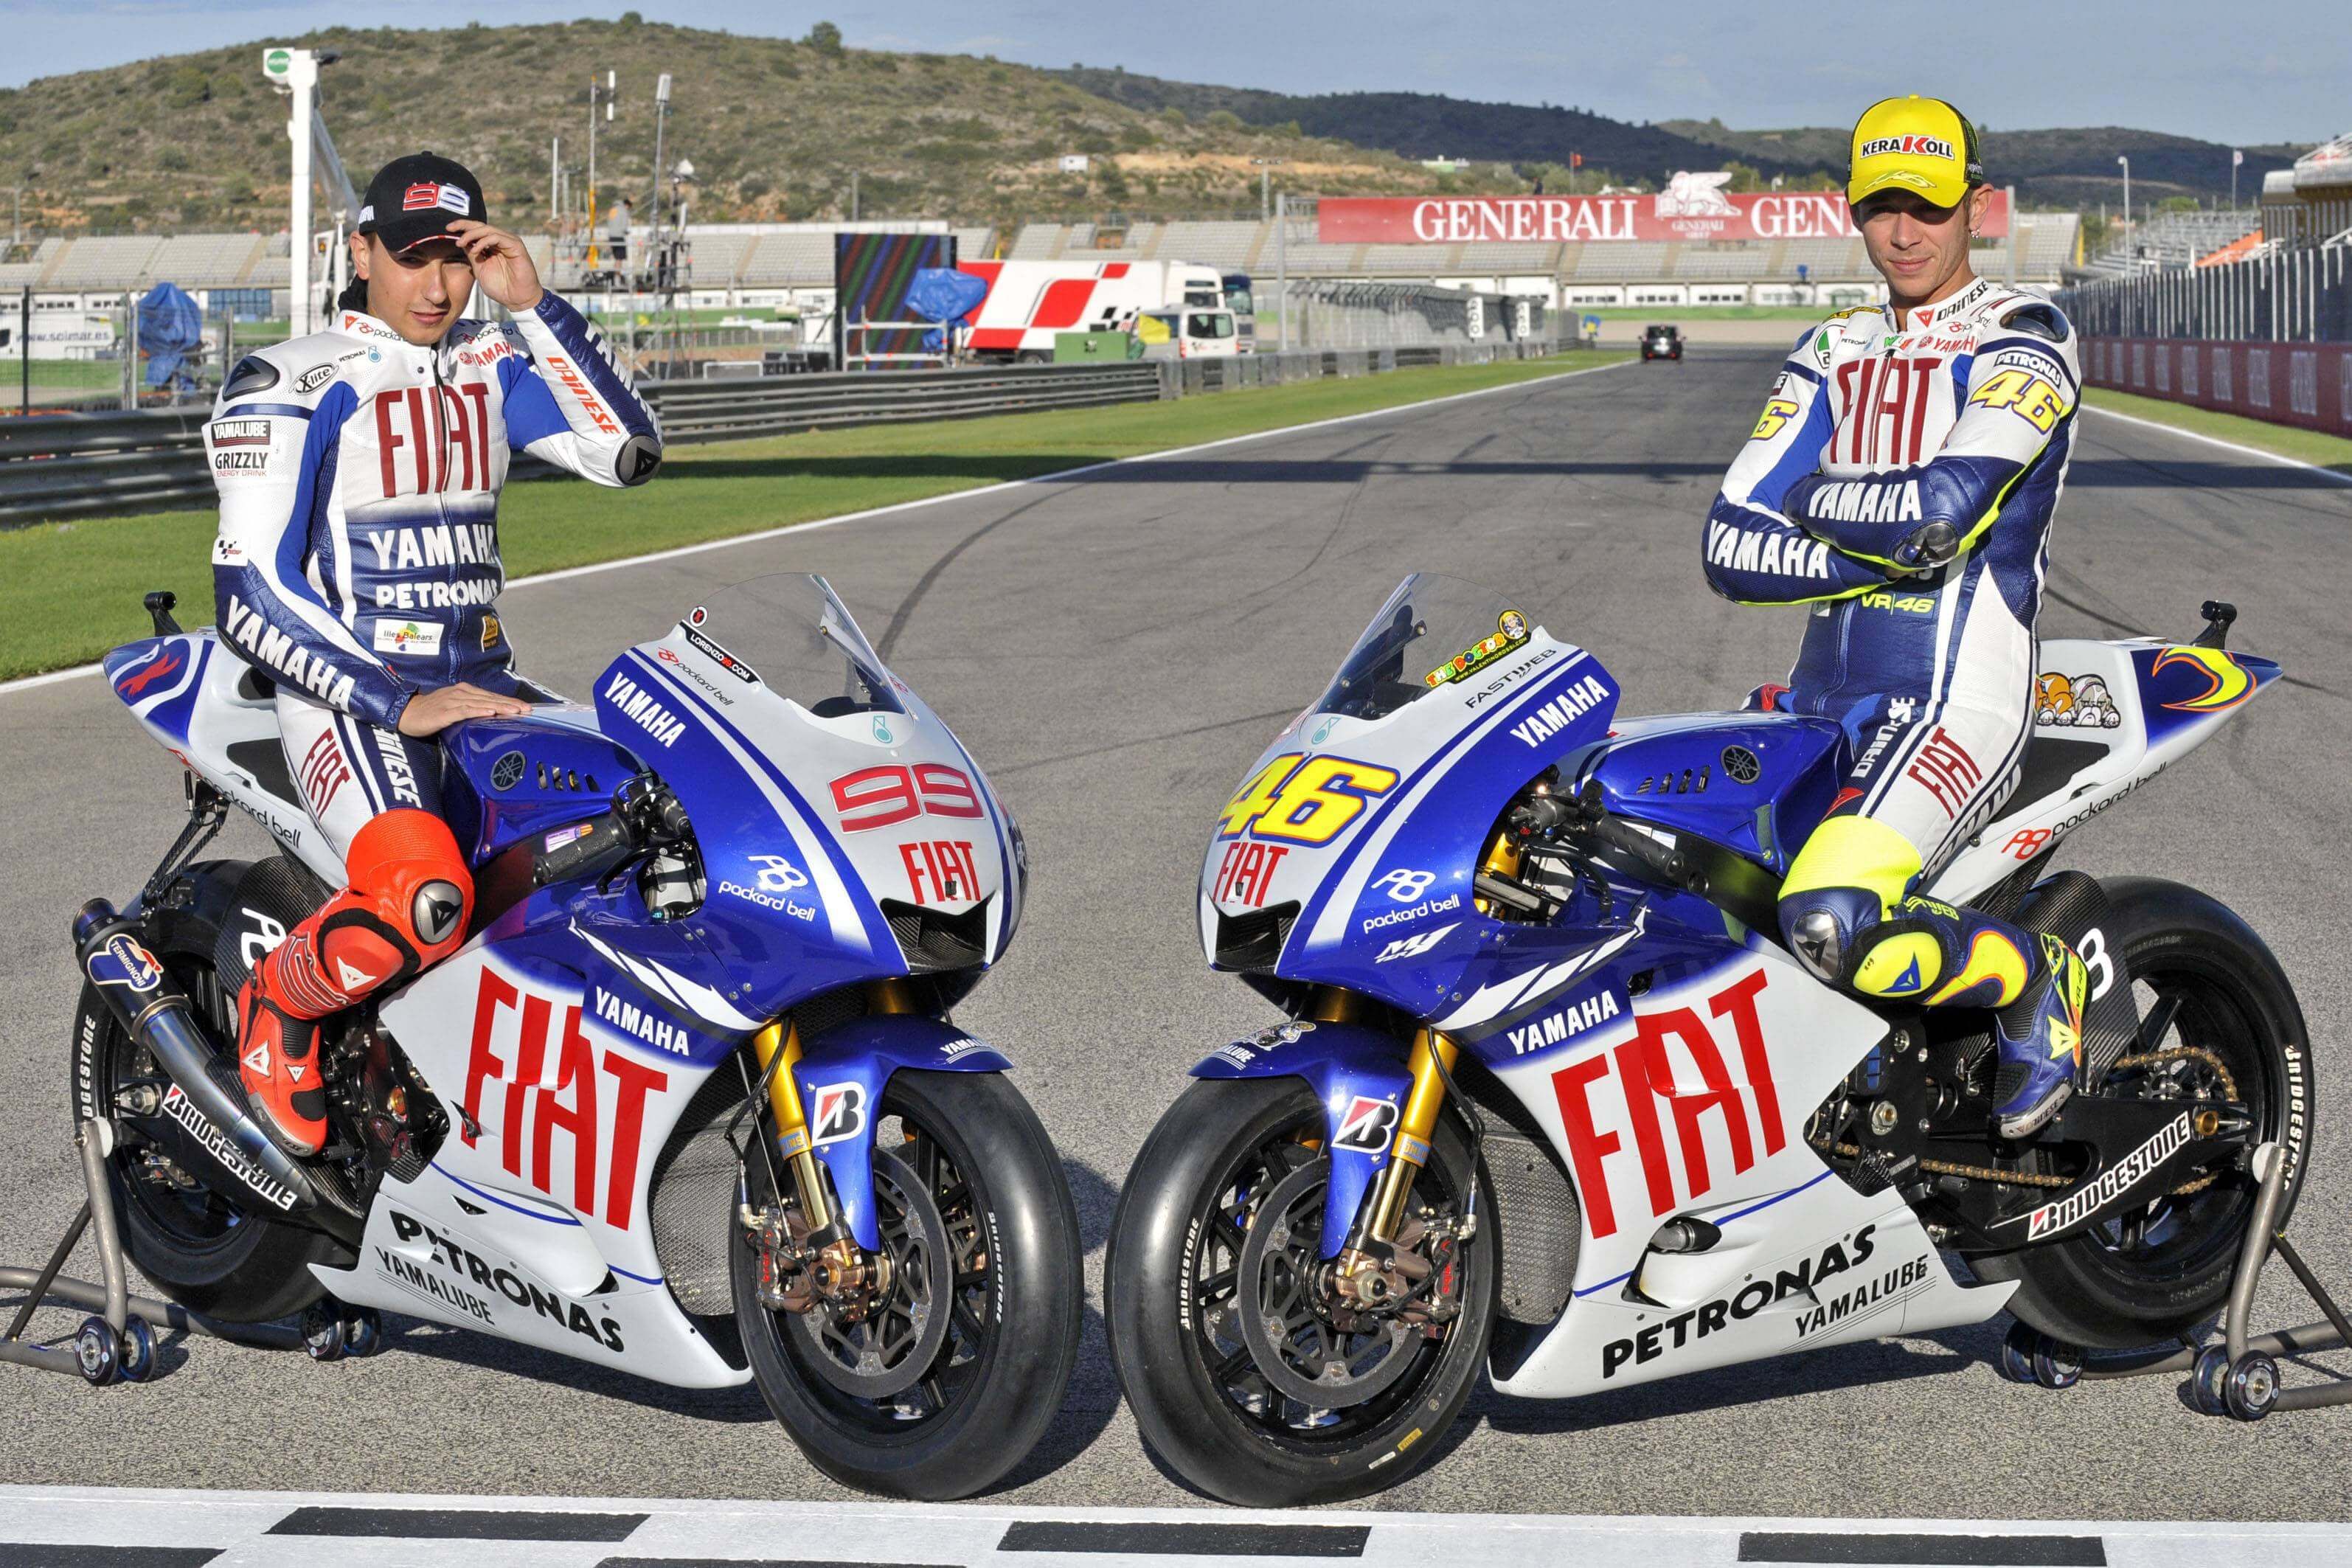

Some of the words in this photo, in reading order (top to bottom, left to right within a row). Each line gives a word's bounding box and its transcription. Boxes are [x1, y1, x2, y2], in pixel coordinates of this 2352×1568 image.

[1861, 134, 1954, 159] KERAKOLL
[403, 181, 471, 217] 99
[1412, 199, 1637, 241] GENERALI
[1751, 196, 1864, 238] GEN
[1968, 368, 2064, 436] 46
[1997, 351, 2062, 387] PETRONAS
[212, 422, 268, 440] YAMALUBE
[375, 381, 490, 498] FIAT
[1829, 357, 1943, 466] FIAT
[215, 451, 268, 470] GRIZZLY
[217, 470, 240, 478] ENERGY
[241, 469, 267, 477] DRINK
[1808, 480, 1922, 524] YAMAHA
[1706, 519, 1831, 579] YAMAHA
[224, 594, 355, 715] YAMAHA
[403, 631, 433, 641] Balears
[690, 633, 751, 681] LORENZO99.COM
[1426, 661, 1455, 687] THE
[1453, 631, 1508, 672] DOCTOR
[603, 671, 687, 749] YAMAHA
[673, 662, 718, 693] packard
[713, 688, 735, 706] bell
[1464, 648, 1557, 709] FASTWEB
[1509, 674, 1609, 749] YAMAHA
[300, 726, 351, 822] FIAT
[828, 762, 987, 834] 99
[1217, 750, 1401, 849] 46
[1907, 726, 1983, 821] FIAT
[271, 814, 302, 850] bell
[2051, 781, 2131, 841] packard
[718, 880, 786, 912] packard
[787, 902, 816, 923] bell
[898, 840, 982, 906] FIAT
[1213, 842, 1290, 908] FIAT
[1363, 901, 1429, 934] packard
[1430, 893, 1460, 914] bell
[110, 939, 149, 988] TERMIGNONI
[595, 985, 690, 1056] YAMAHA
[1507, 989, 1620, 1056] YAMAHA
[459, 963, 669, 1232] FIAT
[1550, 967, 1787, 1241] FIAT
[162, 1083, 298, 1210] BRIDGESTONE
[2027, 1110, 2192, 1242] BRIDGESTONE
[373, 1244, 496, 1326] YAMALUBE
[1179, 1218, 1200, 1331] BRIDGESTONE
[1603, 1223, 1877, 1380] PETRONAS
[1794, 1253, 1929, 1338] YAMALUBE
